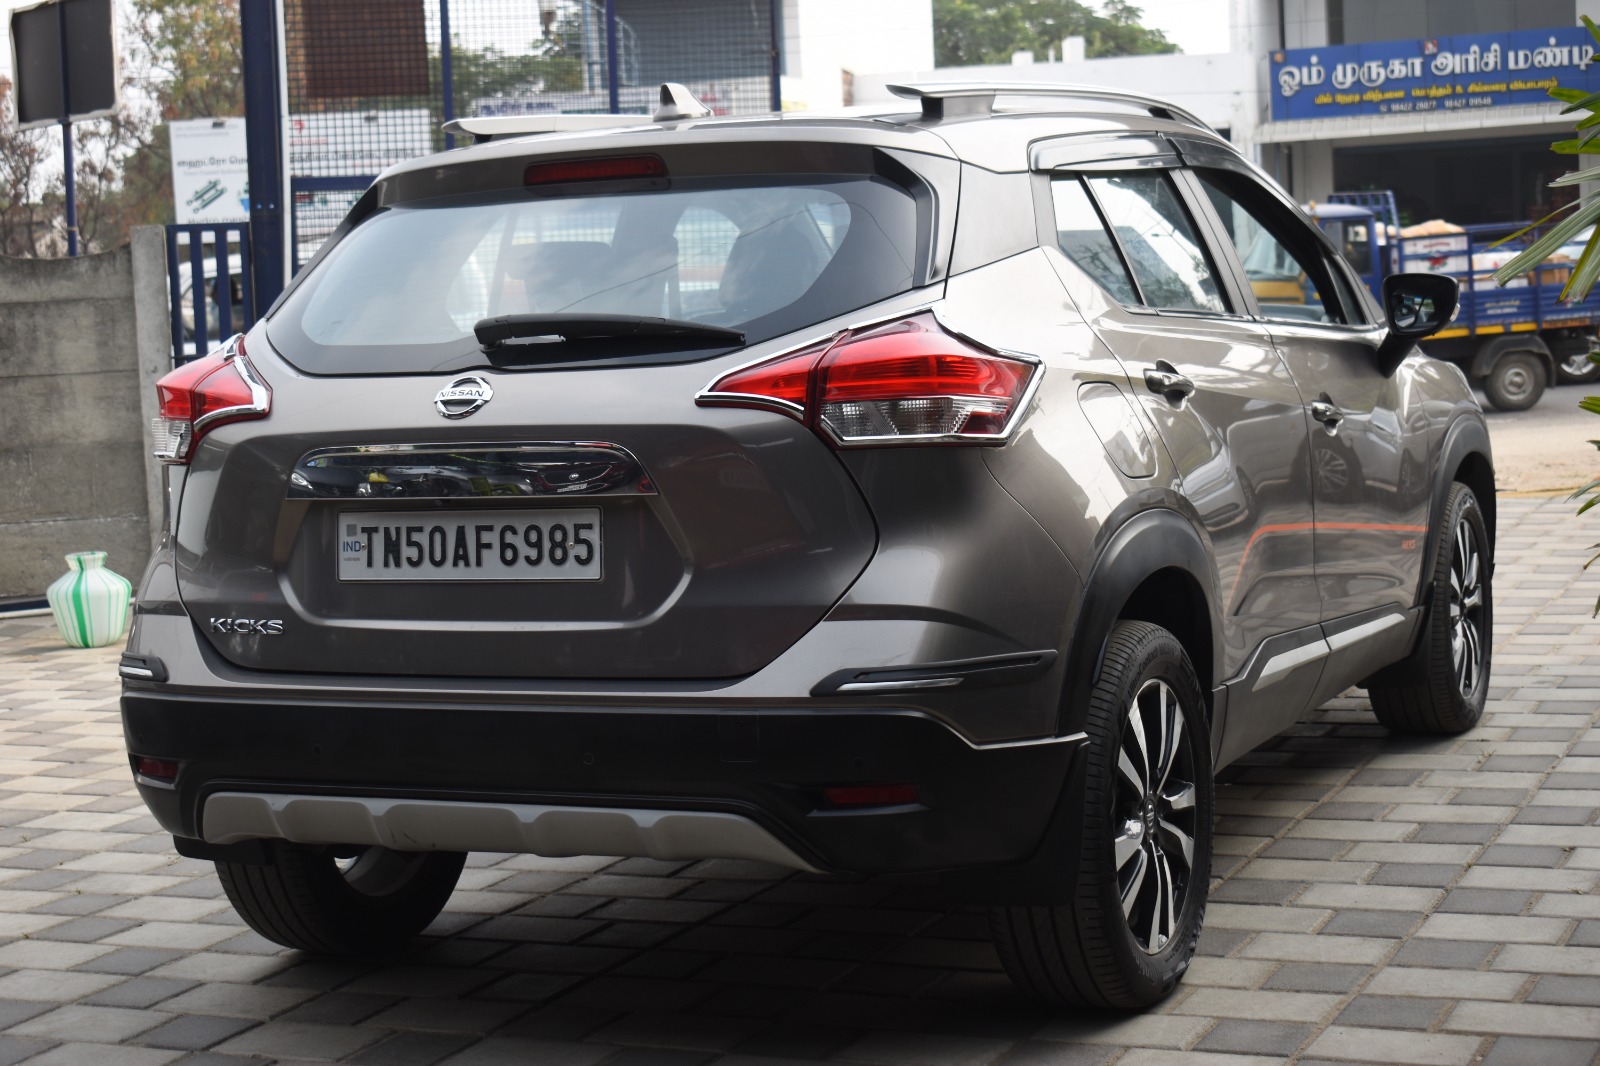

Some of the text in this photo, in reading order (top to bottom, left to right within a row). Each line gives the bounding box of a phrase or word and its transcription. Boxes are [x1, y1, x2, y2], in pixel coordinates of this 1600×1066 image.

[1279, 54, 1325, 97] ஓம்
[1332, 56, 1424, 89] முருகா
[1431, 43, 1500, 76] அரிசி
[439, 389, 485, 398] NISSAN
[342, 541, 361, 552] IND
[360, 523, 595, 568] TN50AF6985
[210, 617, 284, 634] KICKS
